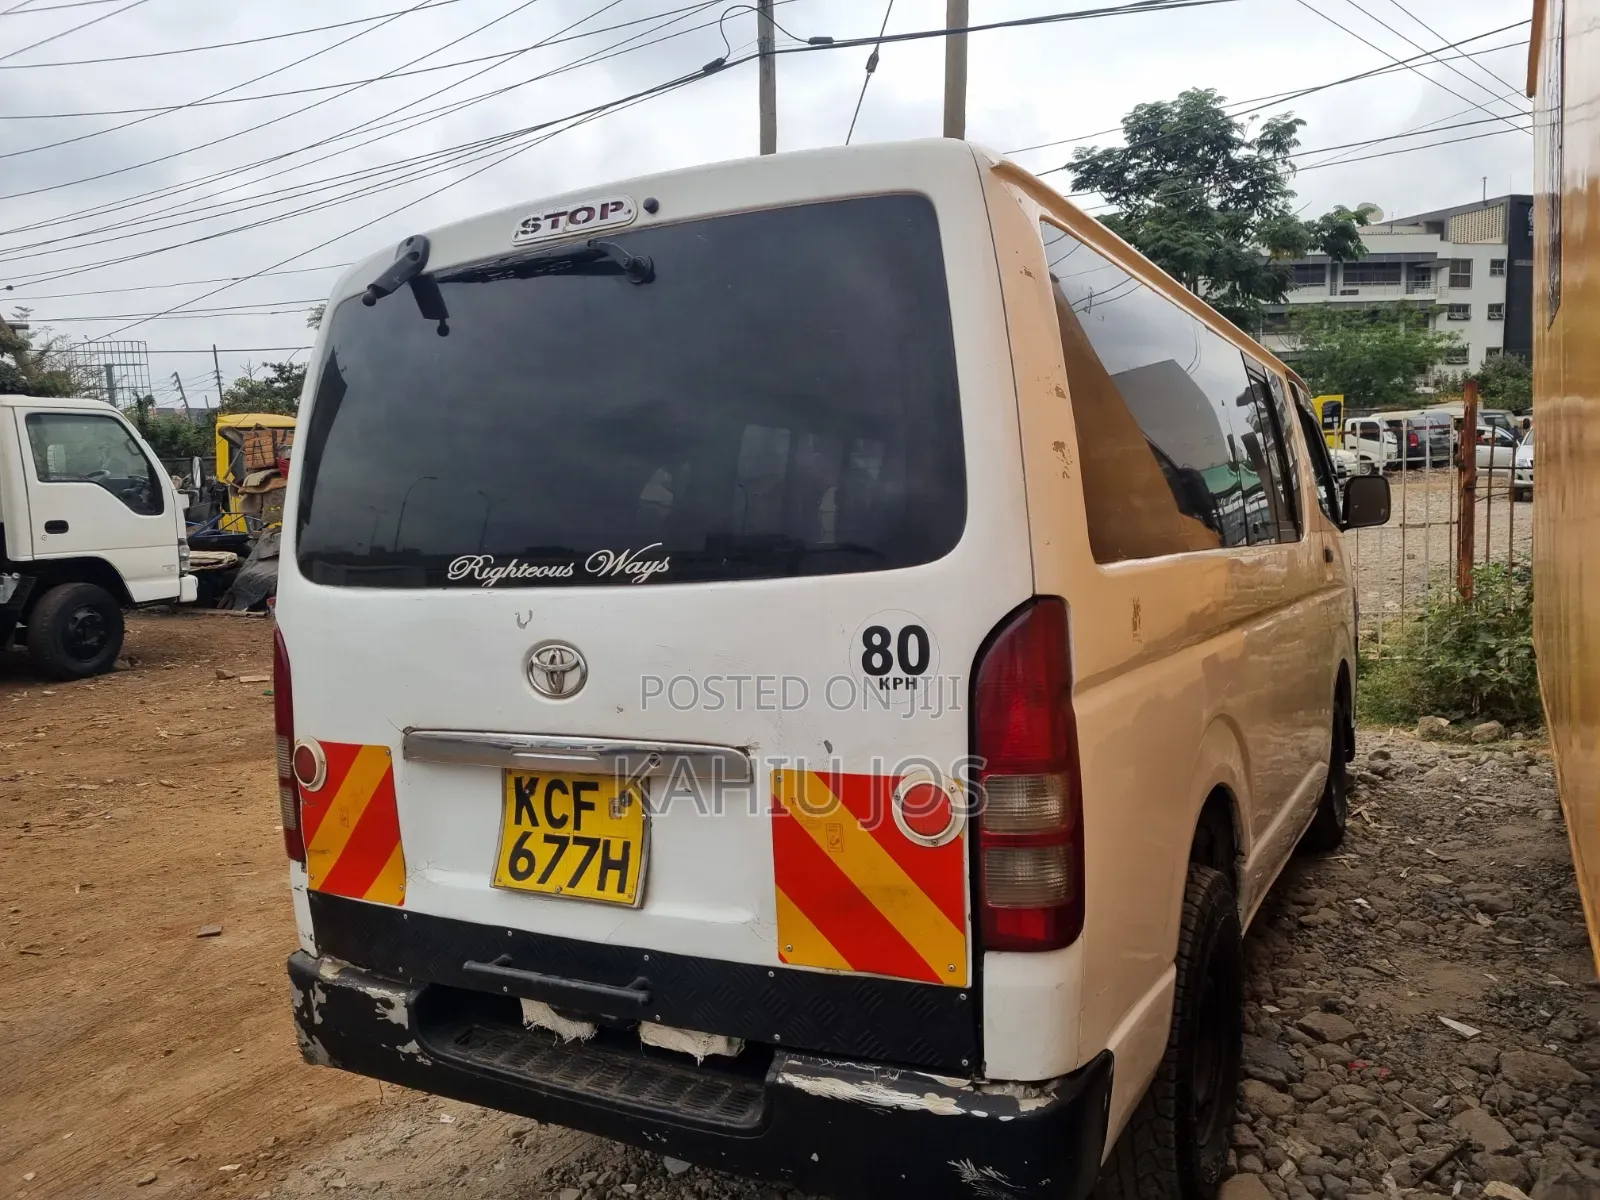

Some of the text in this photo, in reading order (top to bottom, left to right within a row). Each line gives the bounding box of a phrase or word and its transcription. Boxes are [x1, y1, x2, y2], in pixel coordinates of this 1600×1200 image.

[520, 201, 625, 235] STOP
[447, 542, 670, 587] Righteous Ways
[861, 624, 930, 676] 80
[879, 677, 918, 691] KPH
[514, 775, 600, 831] KCF
[508, 831, 631, 893] 677H
